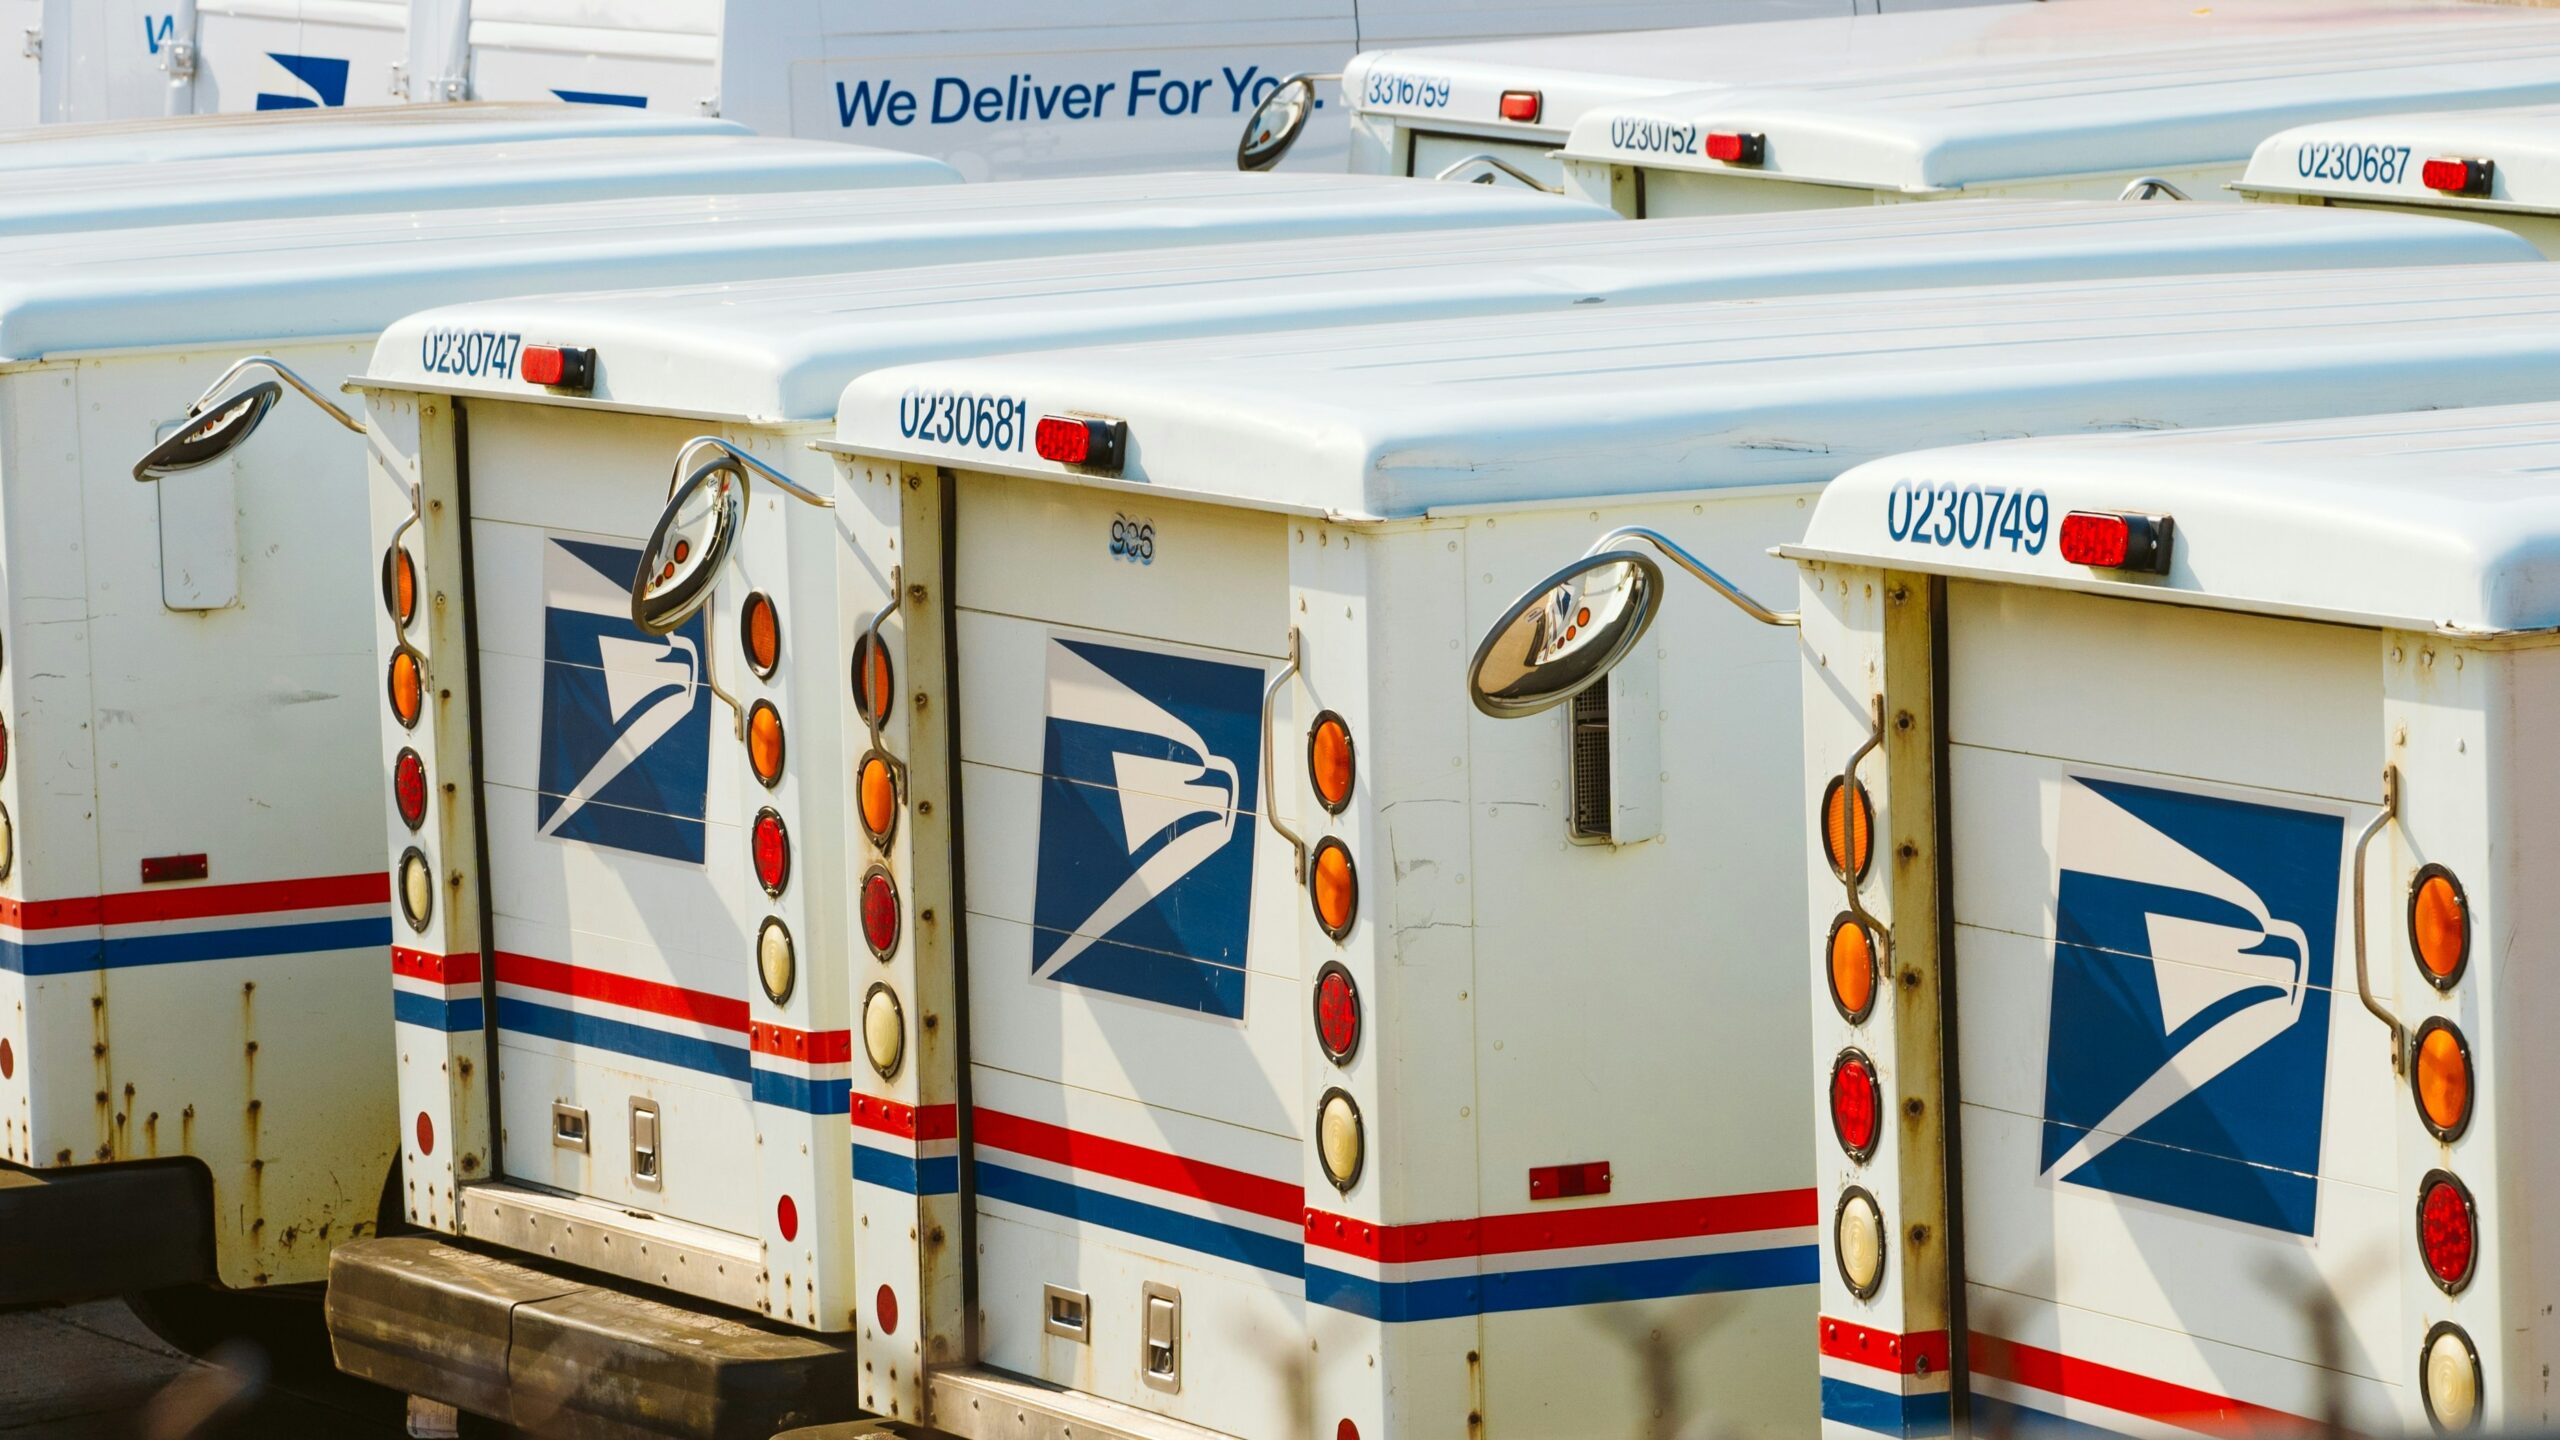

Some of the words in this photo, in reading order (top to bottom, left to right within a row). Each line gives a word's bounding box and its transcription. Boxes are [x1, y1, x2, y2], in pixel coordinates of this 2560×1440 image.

[835, 79, 917, 128] We
[931, 74, 1115, 125] Deliver
[1127, 69, 1213, 117] For
[1222, 65, 1324, 113] Yo.
[1369, 72, 1451, 108] 3316759
[1611, 116, 1698, 155] 0230752
[2298, 141, 2411, 185] 0230687
[422, 325, 522, 380] 0230747
[899, 384, 1027, 453] 0230681
[1887, 477, 2049, 556] 0230749
